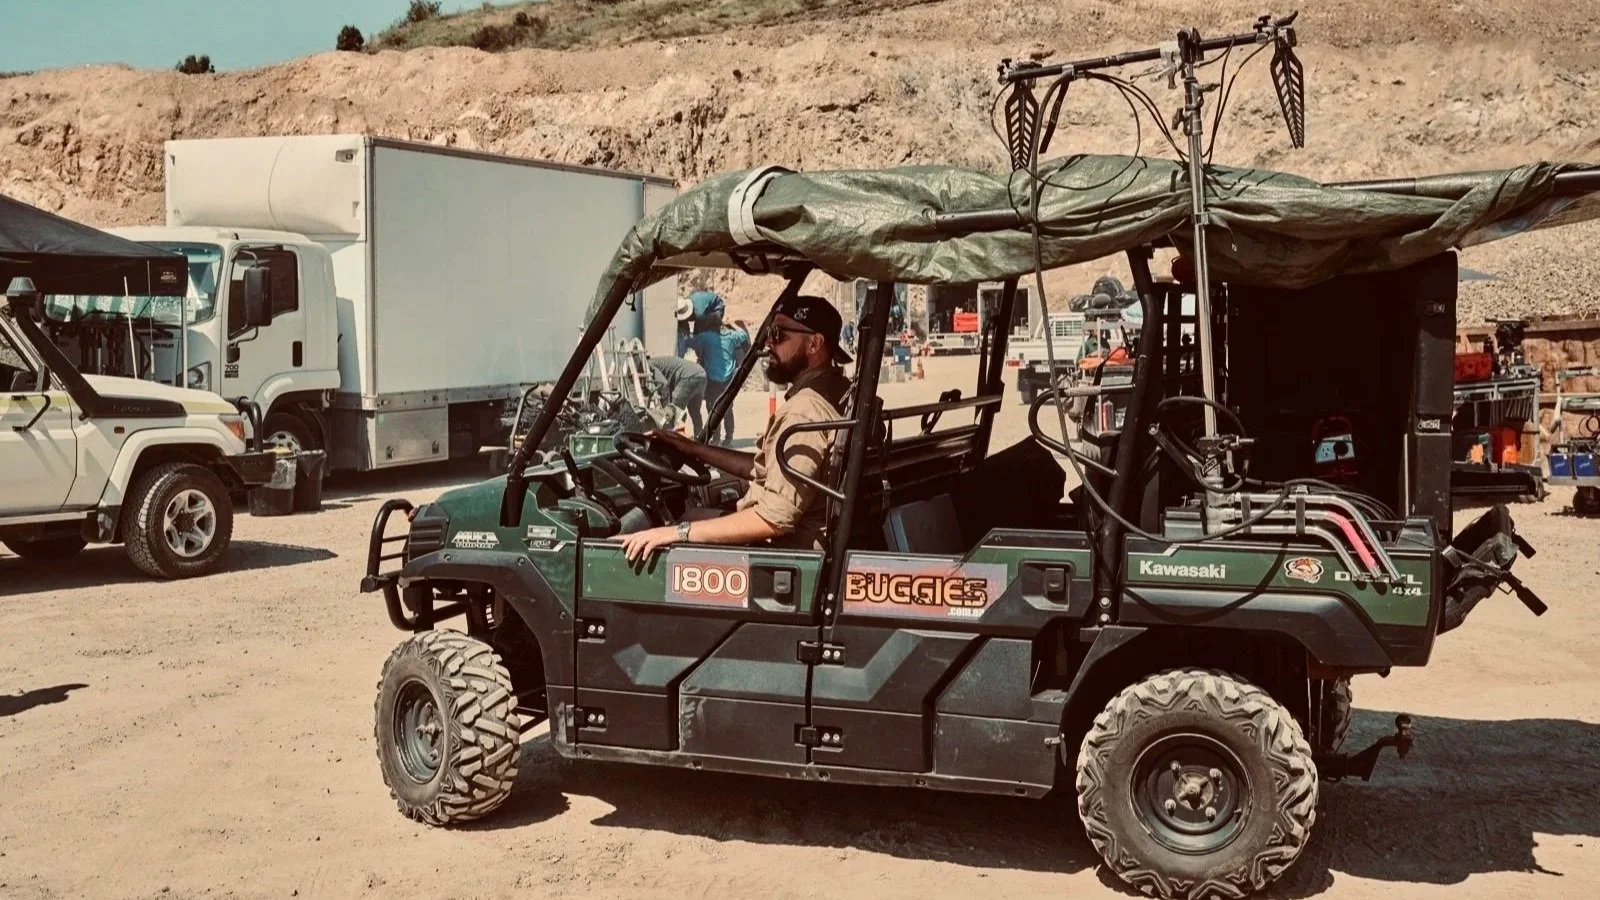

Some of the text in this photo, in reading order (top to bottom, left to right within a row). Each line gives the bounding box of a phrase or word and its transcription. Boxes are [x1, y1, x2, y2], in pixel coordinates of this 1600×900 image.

[672, 563, 748, 597] 1800
[1139, 559, 1226, 579] Kawasaki
[844, 571, 988, 608] BUGGIES
